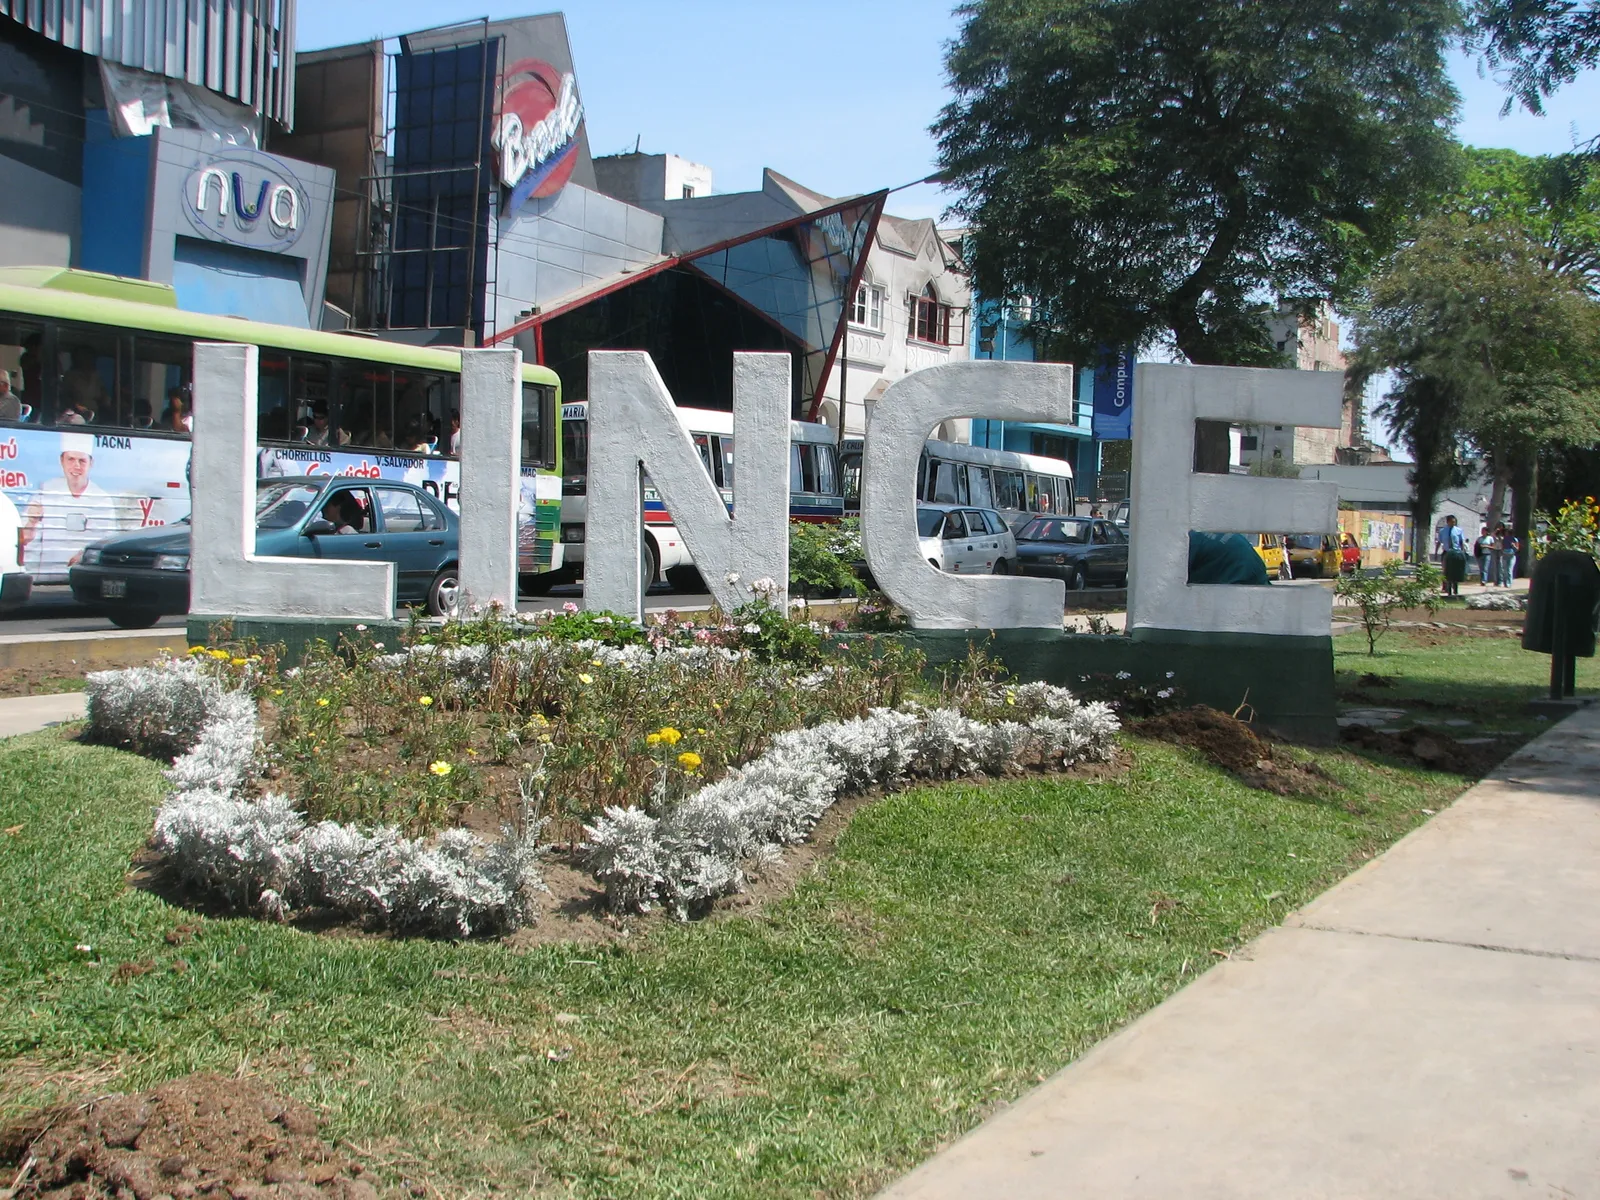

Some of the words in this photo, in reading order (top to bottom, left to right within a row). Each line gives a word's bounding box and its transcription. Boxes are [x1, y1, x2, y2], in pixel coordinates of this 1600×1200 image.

[562, 407, 585, 418] MARIA
[94, 436, 131, 450] TACNA
[275, 449, 332, 463] CHORRILLOS
[375, 456, 425, 469] V.SALVADOR
[0, 469, 26, 487] ien
[188, 342, 1344, 637] LINCE
